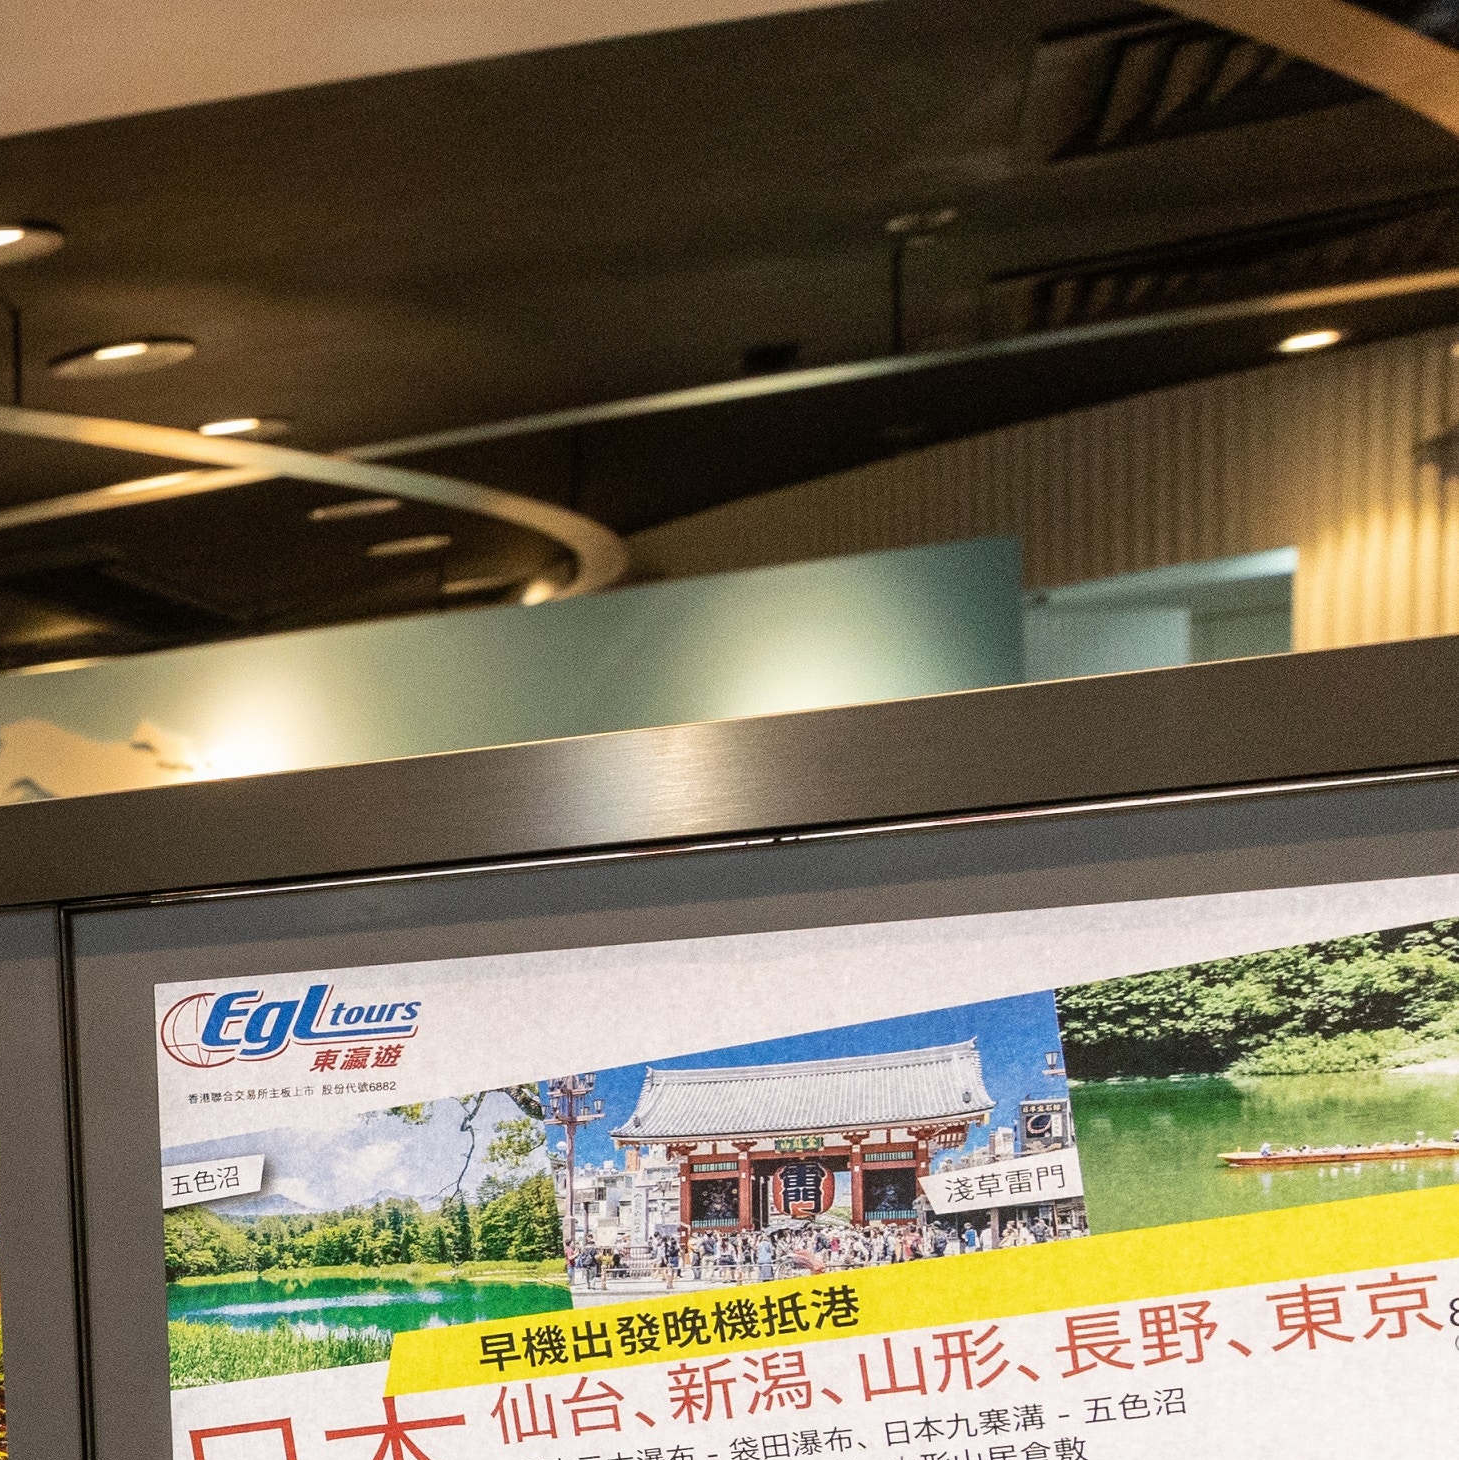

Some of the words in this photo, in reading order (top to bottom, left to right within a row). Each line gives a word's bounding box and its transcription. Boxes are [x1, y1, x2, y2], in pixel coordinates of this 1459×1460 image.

[330, 1001, 422, 1026] tours
[309, 1044, 405, 1072] 東瀛遊
[188, 1085, 315, 1105] 香港聯合交易所主板上市
[321, 1081, 397, 1097] 股份代號6882
[170, 1165, 240, 1197] 五色沼
[945, 1164, 1066, 1203] 淺草雷門
[478, 1285, 861, 1373] 早機出發晚機抵港
[1083, 1387, 1188, 1426] 五色沼
